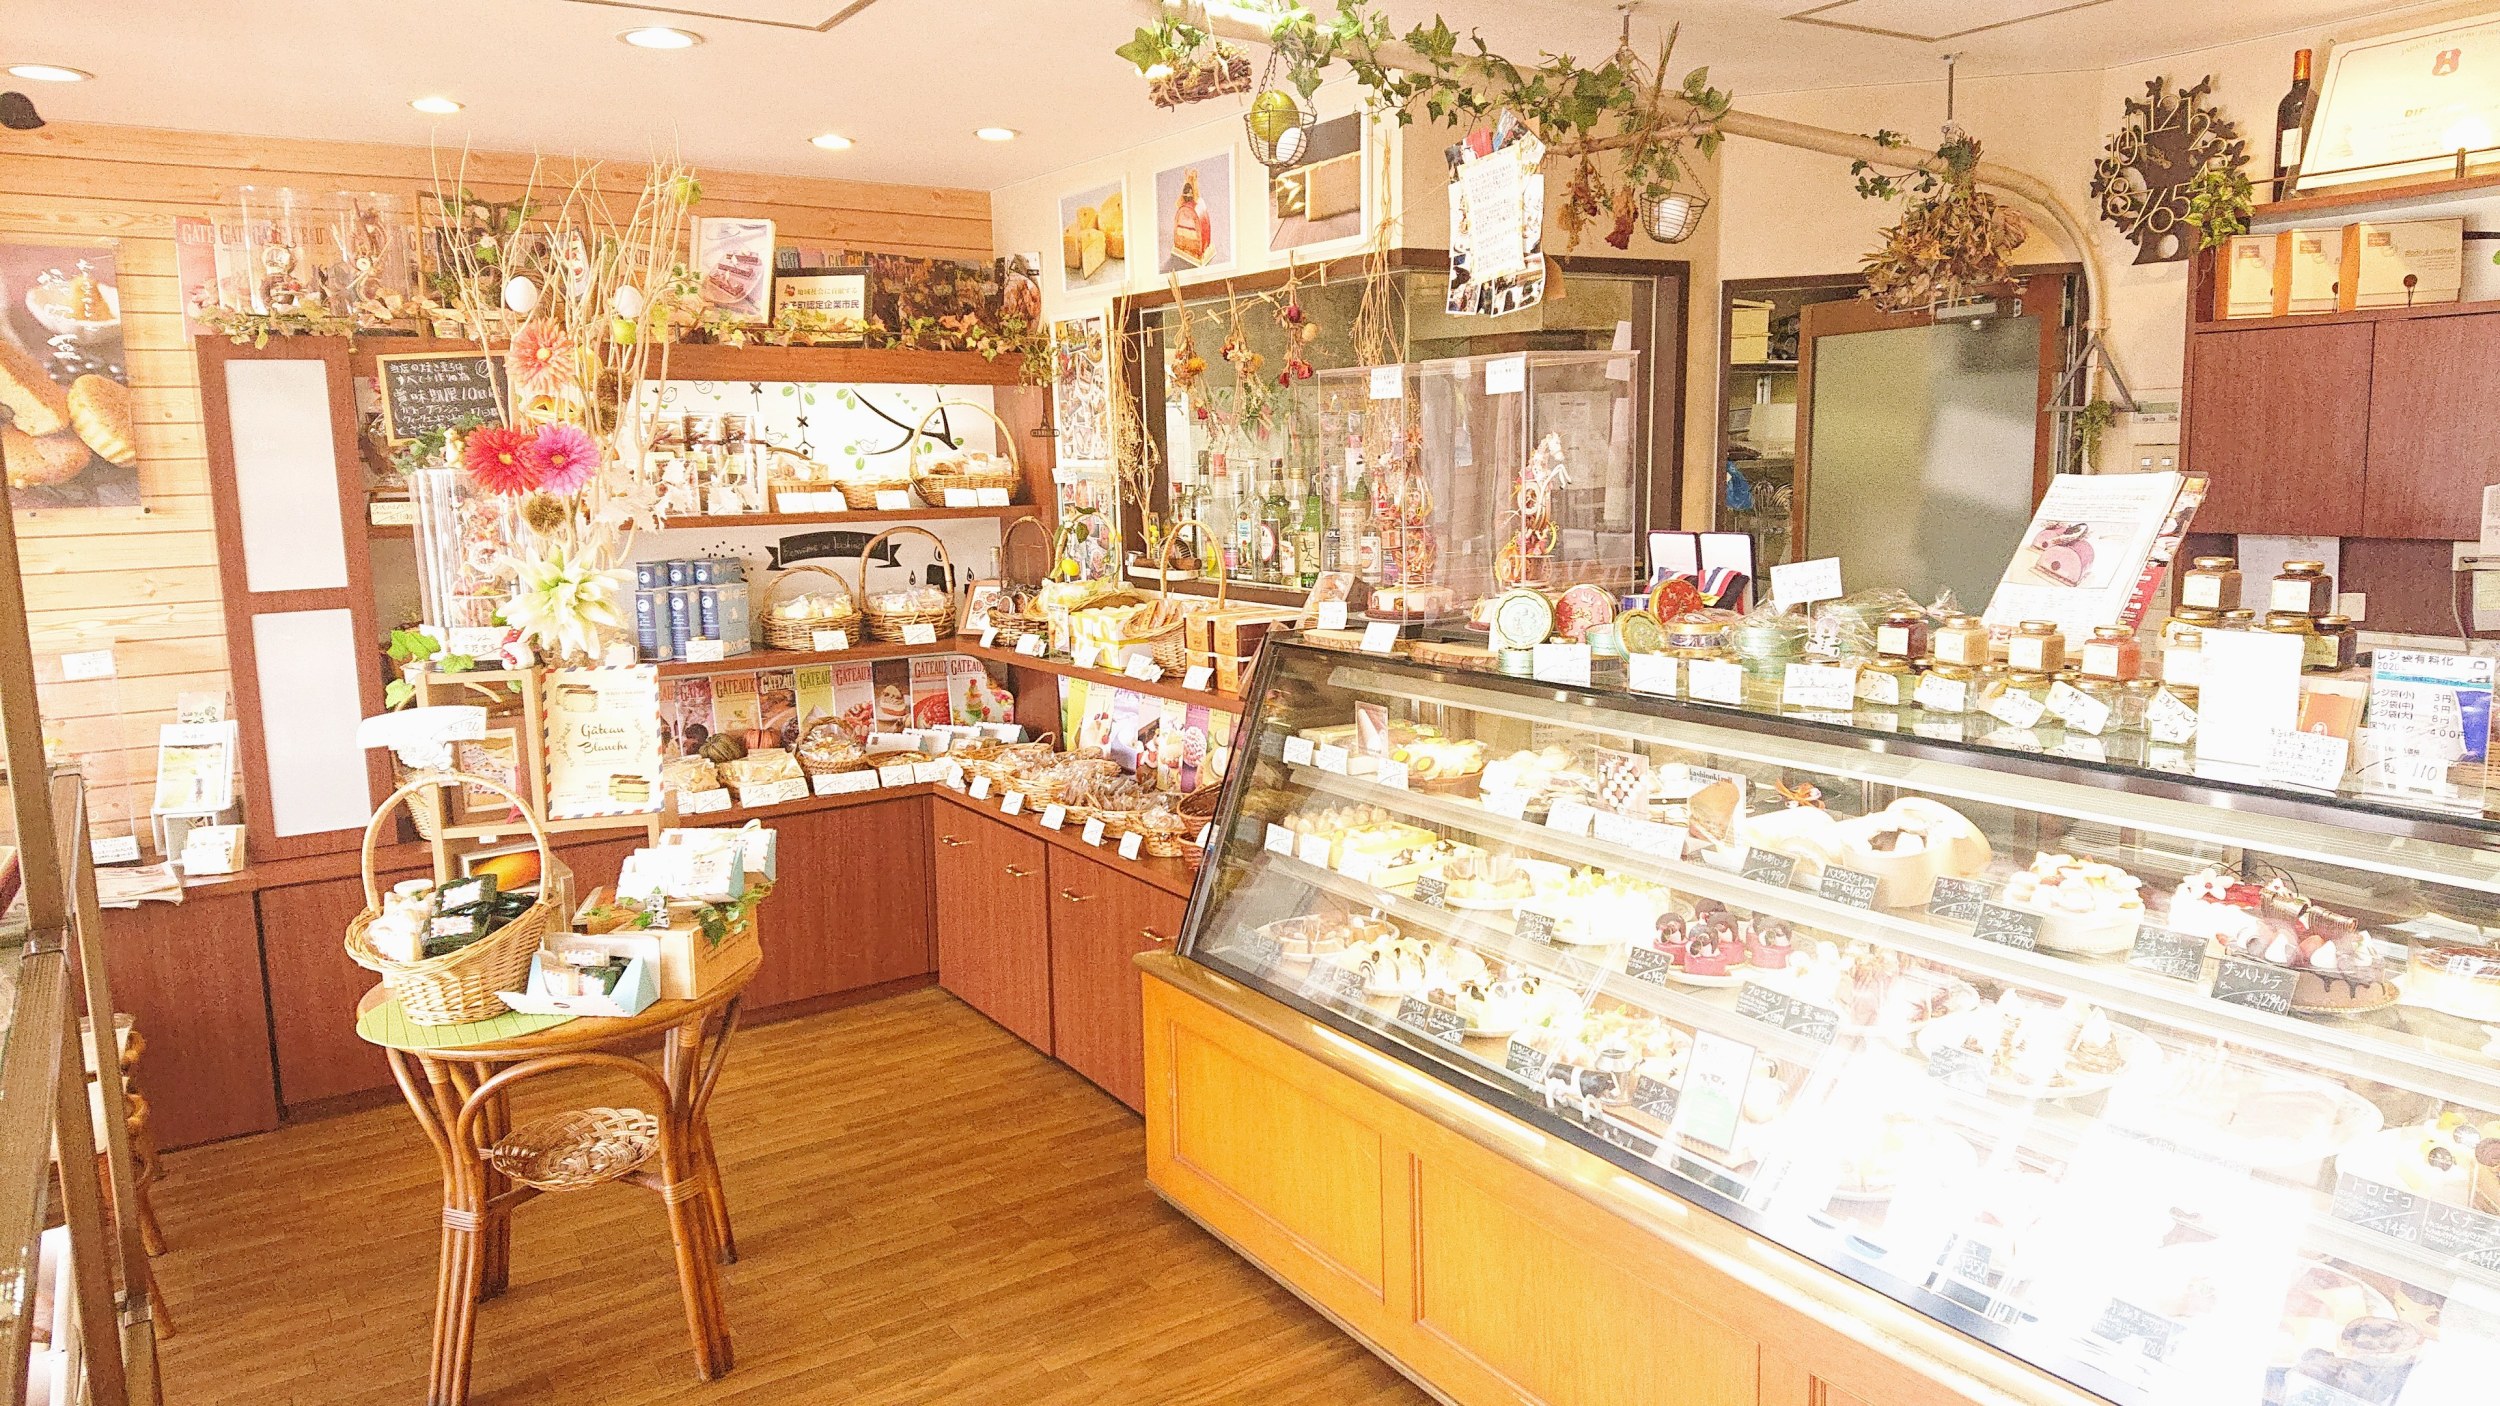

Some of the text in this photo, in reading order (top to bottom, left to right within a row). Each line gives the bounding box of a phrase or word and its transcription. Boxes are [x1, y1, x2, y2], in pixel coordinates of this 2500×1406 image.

[2146, 94, 2180, 133] 12
[2181, 97, 2192, 134] 1
[2188, 113, 2211, 151] 2
[2106, 130, 2138, 167] 10
[2099, 157, 2121, 195] 9
[2107, 177, 2131, 216] 8
[2123, 189, 2154, 231] 7
[2148, 187, 2174, 233] 6
[2171, 182, 2192, 221] 5
[779, 299, 860, 310] 太子町認定企業市民
[2377, 651, 2454, 666] レジ袋有料化
[2371, 699, 2414, 710] レジ袋(中)
[2372, 689, 2415, 700] レジ袋(小)
[2370, 709, 2413, 720] レジ袋(大)
[2353, 1177, 2413, 1209] トロピコ
